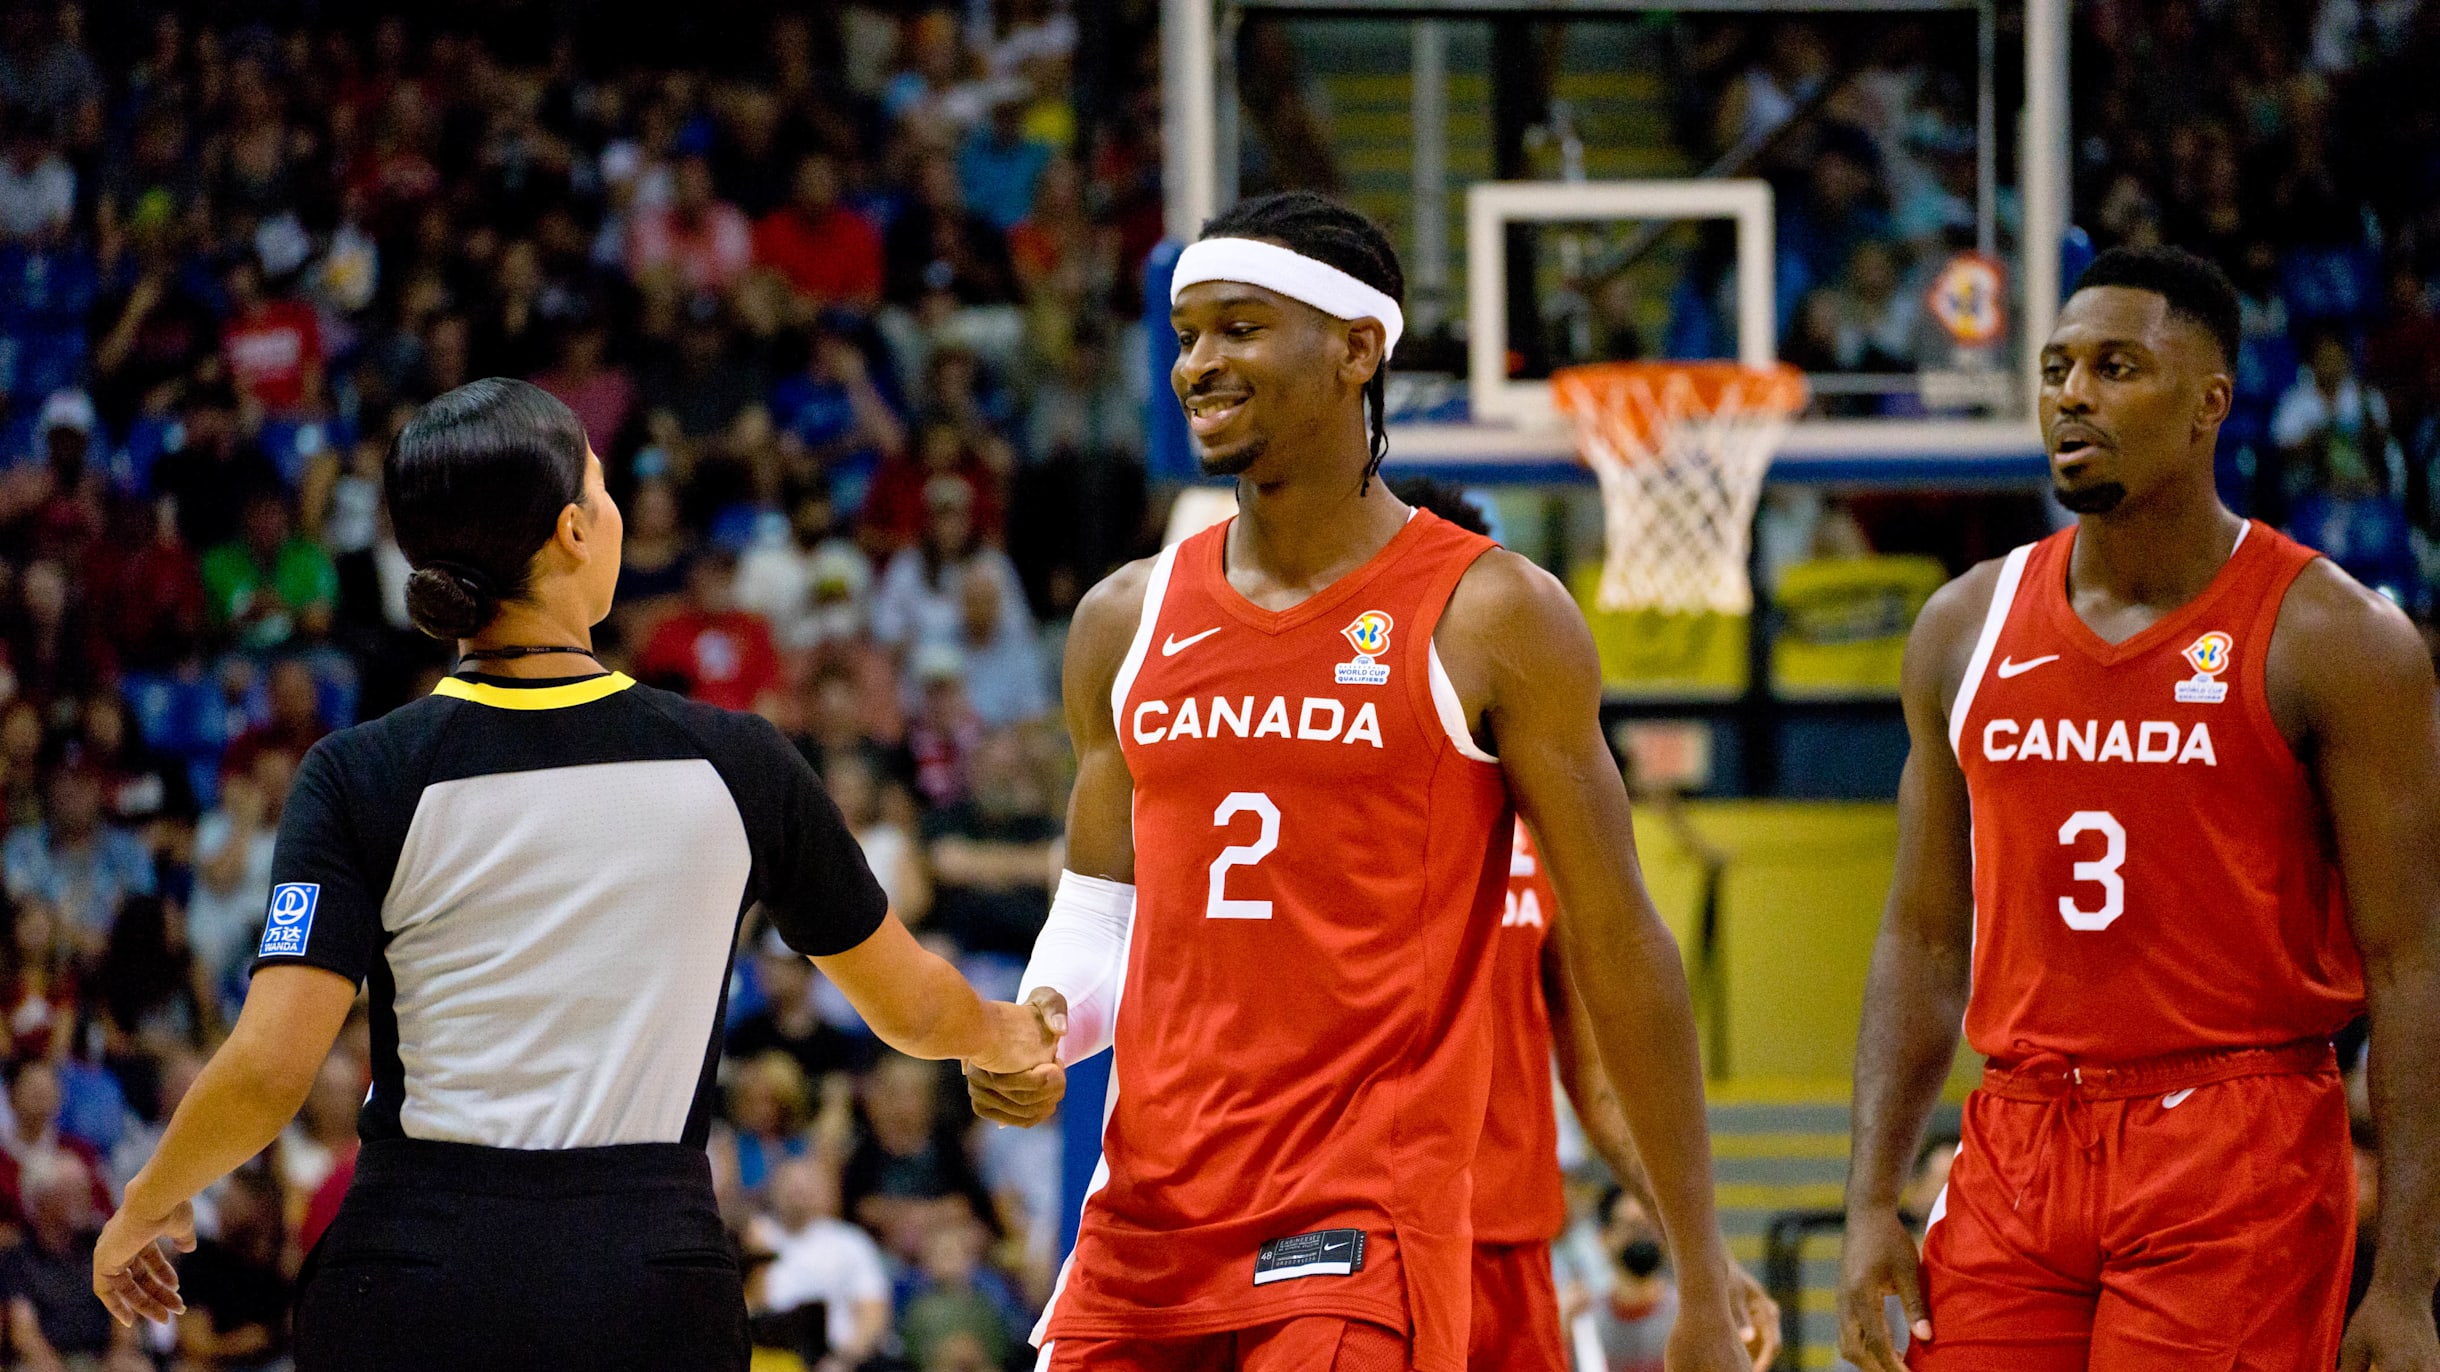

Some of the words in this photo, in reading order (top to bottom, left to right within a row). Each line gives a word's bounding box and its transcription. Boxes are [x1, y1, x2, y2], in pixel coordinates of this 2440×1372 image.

[1369, 669, 1386, 677] CUP
[1133, 695, 1384, 749] CANADA
[1983, 718, 2217, 766] CANADA
[1206, 791, 1281, 919] 2
[2058, 811, 2126, 931] 3
[264, 942, 298, 952] WANDA
[265, 926, 303, 943] 万达
[1261, 1251, 1273, 1261] 48
